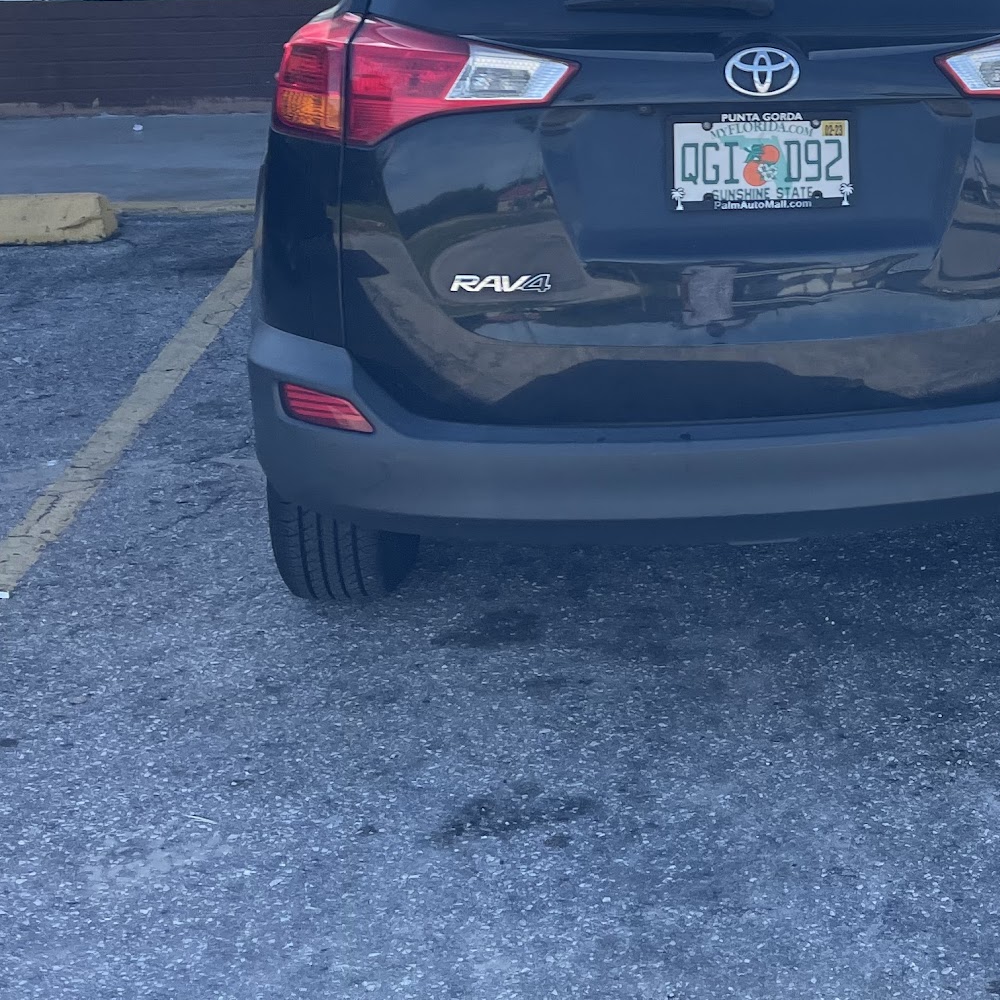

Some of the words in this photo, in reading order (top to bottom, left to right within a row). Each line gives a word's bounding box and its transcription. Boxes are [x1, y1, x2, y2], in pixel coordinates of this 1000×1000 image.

[721, 113, 760, 122] PUNTA
[762, 112, 803, 121] GORDA
[710, 121, 814, 139] MYFLORIDA.COM
[712, 187, 770, 201] SUNSHINE
[777, 186, 813, 200] STATE
[714, 199, 812, 211] PalmAutoMall.com
[450, 273, 552, 293] RAV4
